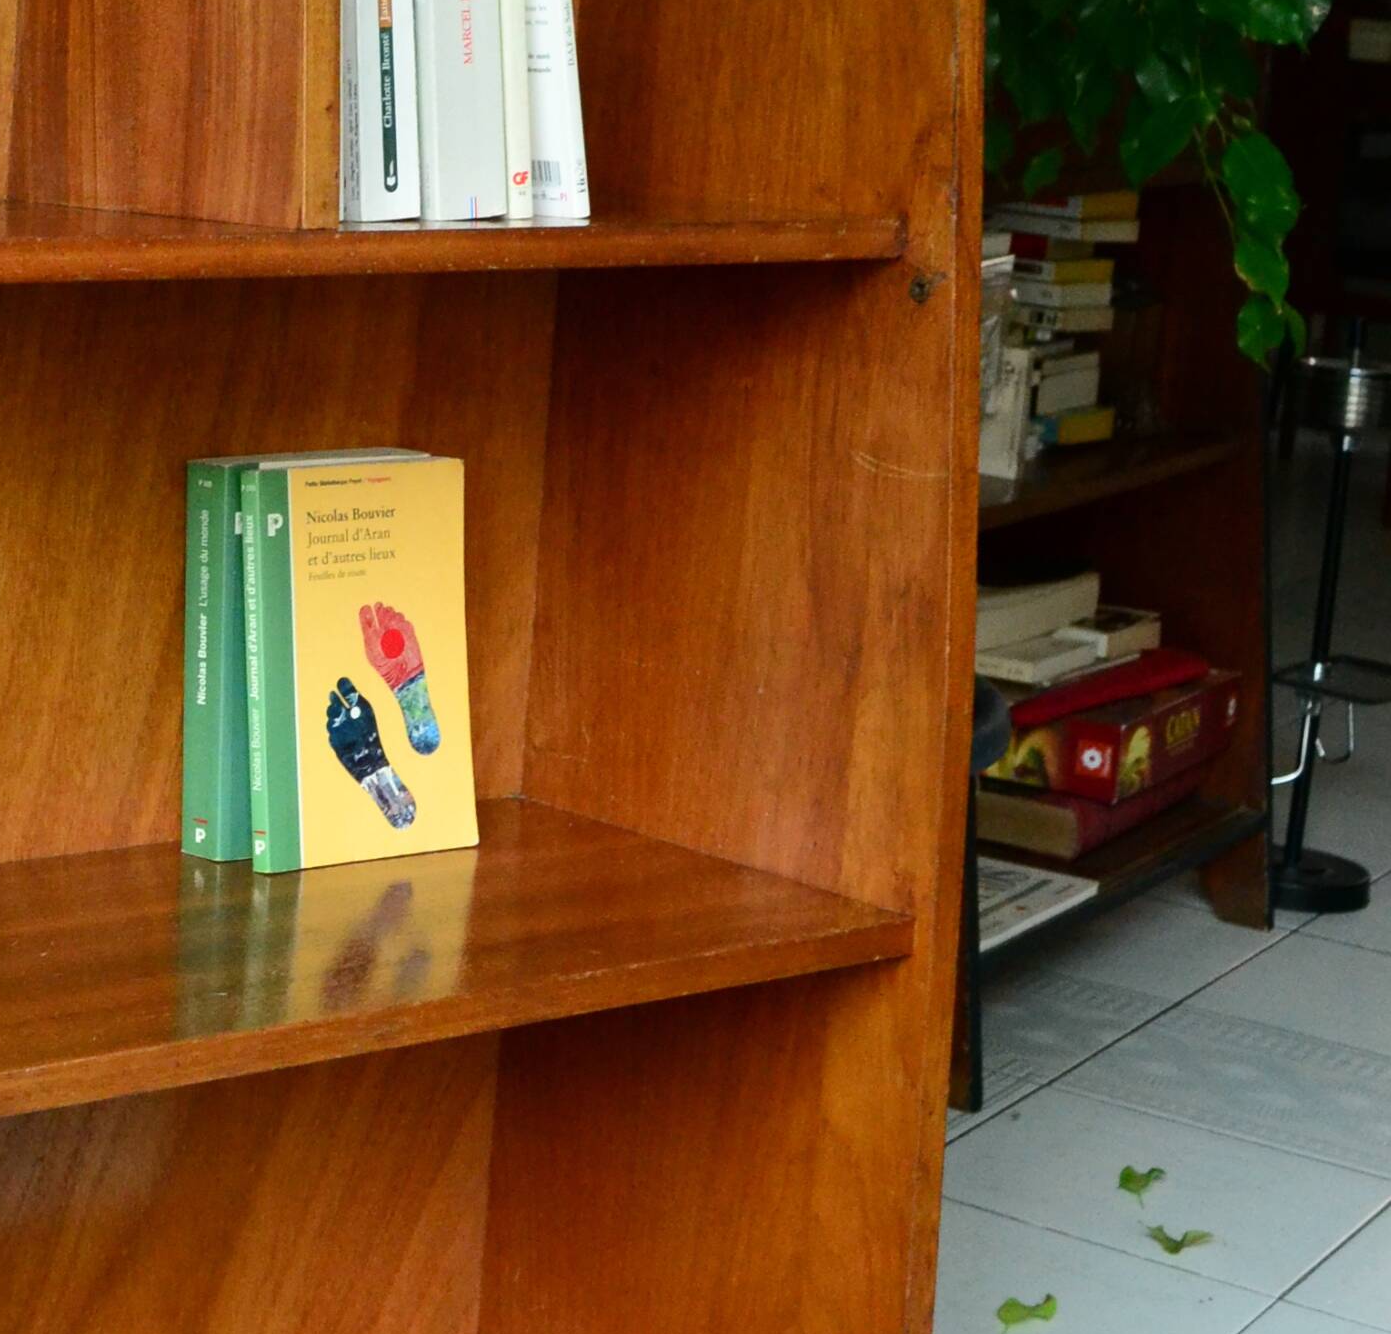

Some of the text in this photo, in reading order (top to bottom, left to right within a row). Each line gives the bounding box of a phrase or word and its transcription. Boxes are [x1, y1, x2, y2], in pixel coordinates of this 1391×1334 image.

[461, 10, 472, 65] MARCEL
[383, 75, 394, 129] Charlotte
[267, 512, 283, 537] P
[306, 506, 396, 524] Nicolas Bouvier
[306, 527, 391, 549] Journal d'Aran
[307, 547, 397, 566] et d'autres lieux
[196, 509, 210, 705] Nicolas Bouvier L'usage du monde
[244, 514, 263, 792] Nicolas Bouvier Journal d'Aran et d'autres lieux
[195, 827, 206, 844] P
[254, 839, 266, 856] P
